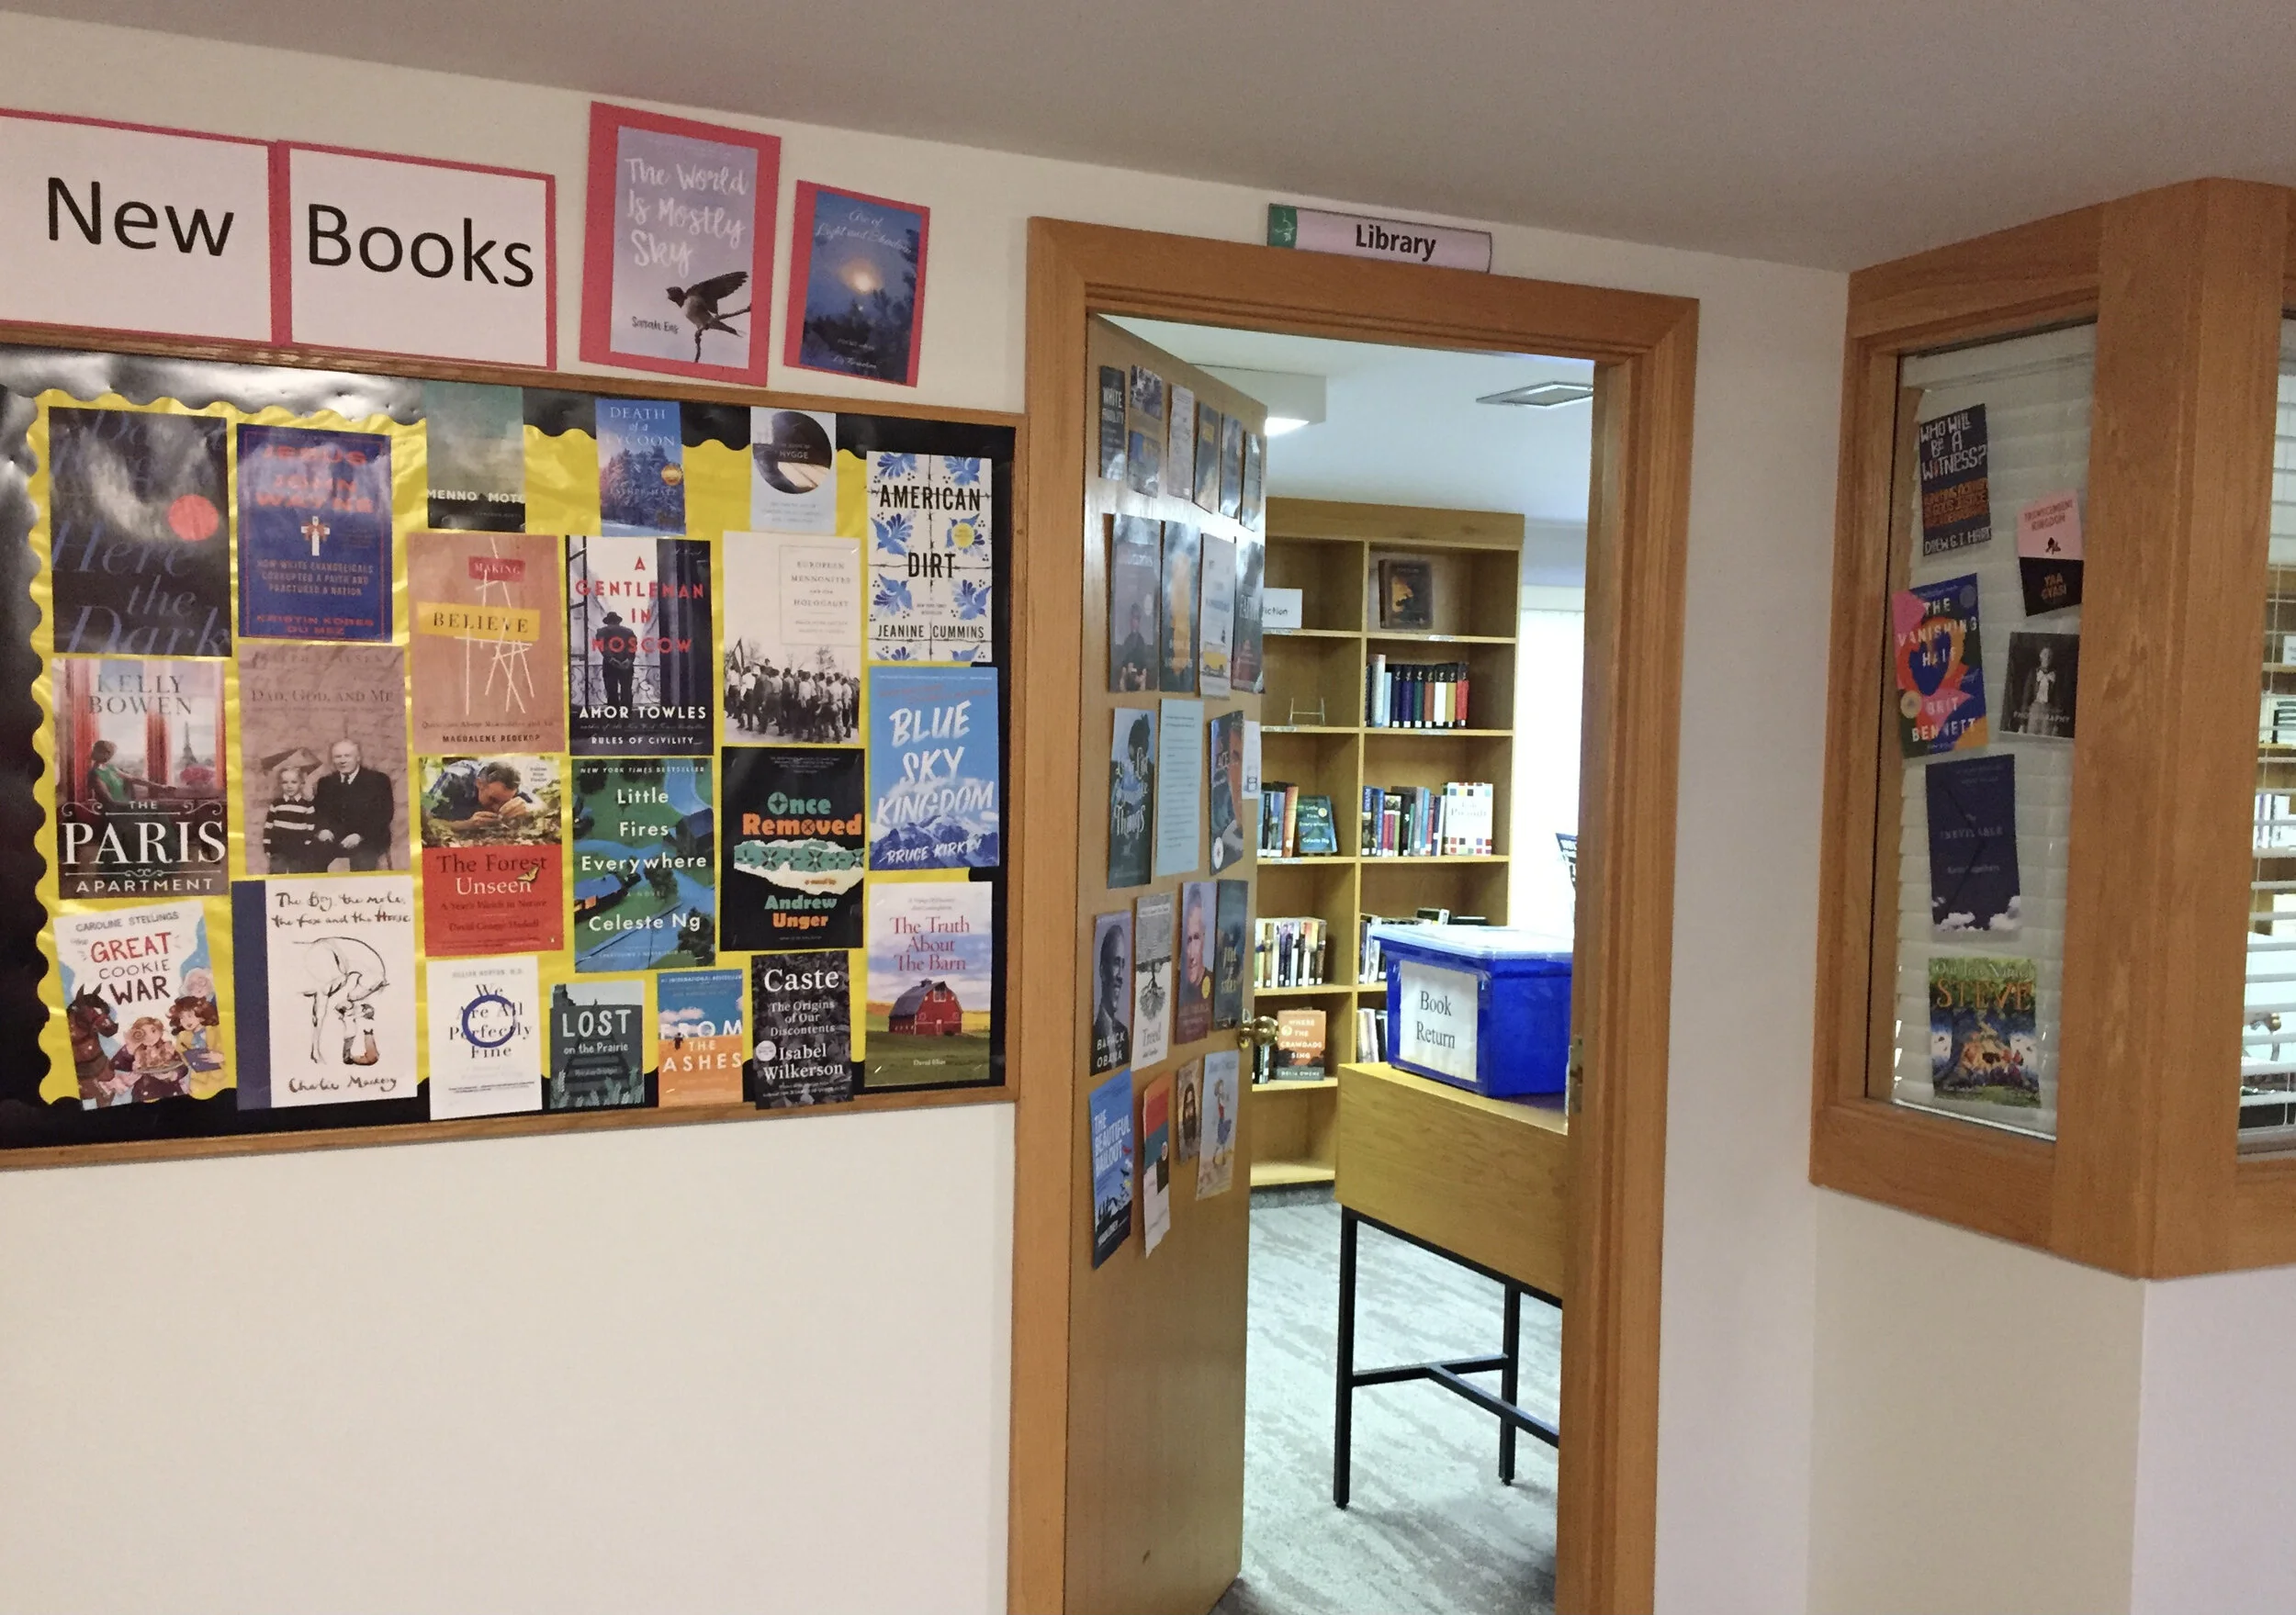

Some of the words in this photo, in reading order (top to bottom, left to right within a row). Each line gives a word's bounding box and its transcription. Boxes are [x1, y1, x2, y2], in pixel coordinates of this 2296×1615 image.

[625, 158, 669, 185] The
[677, 163, 748, 195] World
[627, 191, 648, 223] Is
[658, 200, 746, 248] Mostly
[48, 177, 233, 256] New
[309, 204, 534, 287] Books
[1356, 224, 1436, 262] Library
[631, 230, 692, 279] Sky
[632, 317, 661, 331] Sarah
[610, 407, 666, 420] DEATH
[1919, 421, 1946, 443] WHO
[1952, 431, 1964, 453] A
[780, 450, 809, 459] HYGGE
[1921, 443, 1987, 482] WITNESS?
[426, 489, 478, 501] MENNO
[879, 485, 981, 511] AMERICAN
[51, 521, 193, 578] Here
[473, 562, 521, 575] MAKING
[635, 556, 646, 571] A
[907, 553, 956, 578] DIRT
[127, 574, 197, 617] the
[575, 580, 704, 600] GENTLEMAN
[793, 599, 850, 607] HOLOCAUST
[1924, 598, 1951, 616] THE
[433, 611, 529, 634] BELIEVE
[631, 607, 651, 624] IN
[66, 605, 230, 655] Dark
[878, 624, 924, 638] JEANINE
[932, 624, 985, 639] CUMMINS
[1897, 615, 1978, 647] VANISHING
[591, 637, 692, 654] MOSCOW
[96, 674, 184, 694] KELLY
[89, 695, 193, 715] BOWEN
[579, 705, 629, 719] AMOR
[637, 705, 706, 720] TOWLES
[1927, 696, 1958, 716] BRIT
[889, 700, 972, 748] BLUE
[1911, 717, 1976, 743] BENNETT
[591, 736, 624, 745] RULES
[628, 736, 643, 745] OF
[648, 736, 694, 745] CIVILITY
[899, 746, 965, 787] SKY
[129, 800, 158, 811] THE
[617, 787, 669, 804] Little
[768, 791, 831, 815] Once
[875, 781, 995, 828] KINGDOM
[620, 821, 669, 837] Fires
[742, 813, 862, 836] Removed
[62, 819, 227, 866] PARIS
[436, 855, 478, 874] The
[485, 853, 548, 872] Forest
[581, 852, 707, 874] Everywhere
[884, 847, 929, 864] BRUCE
[75, 878, 213, 893] APARTMENT
[456, 877, 532, 896] Unseen
[275, 892, 300, 907] The
[339, 892, 363, 904] the
[764, 894, 838, 910] Andrew
[75, 919, 122, 932] CAROLINE
[129, 911, 179, 925] STELLINGS
[270, 914, 293, 927] the
[297, 913, 321, 928] fox
[325, 914, 349, 925] and
[589, 915, 663, 932] Celeste
[671, 913, 701, 933] Ng
[772, 913, 828, 929] Unger
[889, 915, 921, 935] The
[926, 914, 970, 934] Truth
[90, 932, 172, 963] GREAT
[906, 935, 955, 953] About
[99, 959, 171, 980] COOKIE
[894, 954, 925, 971] The
[929, 953, 966, 970] Barn
[108, 975, 171, 1005] WAR
[476, 983, 503, 996] We
[763, 969, 840, 993] Caste
[1420, 990, 1452, 1017] Book
[1936, 977, 2032, 1012] STEVE
[456, 1005, 489, 1019] Are
[770, 1001, 791, 1015] The
[793, 1000, 835, 1014] Origins
[562, 1009, 632, 1037] LOST
[785, 1012, 797, 1024] of
[798, 1012, 819, 1024] Our
[658, 1019, 742, 1040] FROM
[770, 1023, 836, 1038] Discontents
[1416, 1021, 1456, 1049] Return
[470, 1045, 512, 1059] Fine
[578, 1043, 594, 1054] the
[597, 1041, 629, 1053] Prairie
[689, 1039, 716, 1051] THE
[778, 1043, 827, 1061] Isabel
[661, 1052, 742, 1072] ASHES
[762, 1063, 843, 1081] Wilkerson
[287, 1076, 339, 1093] Charlie
